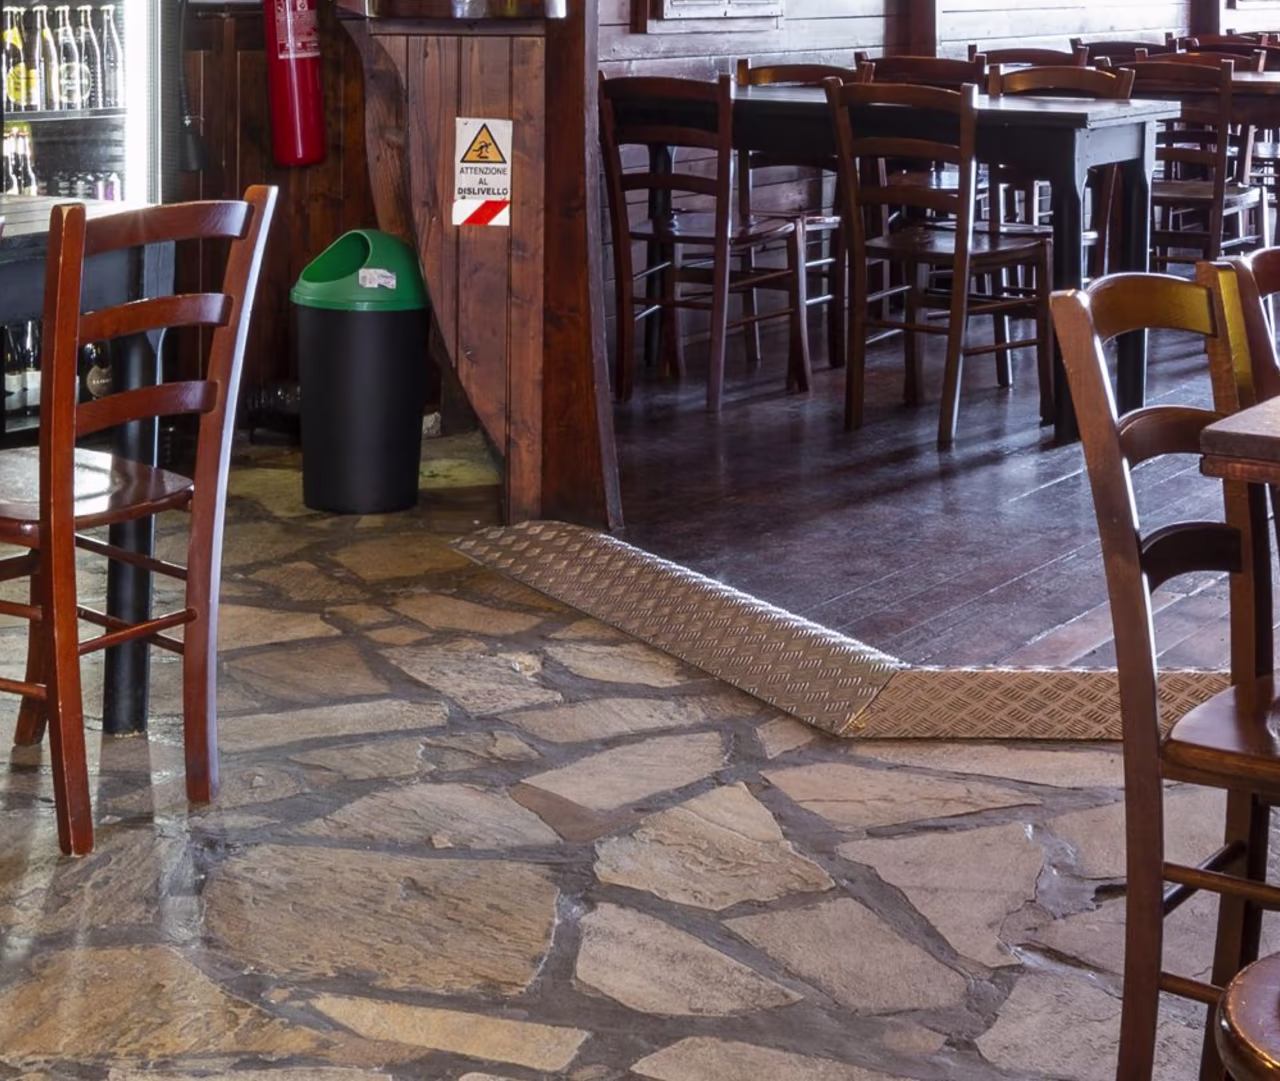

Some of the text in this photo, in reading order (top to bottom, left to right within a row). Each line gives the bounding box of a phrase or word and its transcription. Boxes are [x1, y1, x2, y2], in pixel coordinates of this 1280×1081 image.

[460, 166, 507, 175] ATTENZIONE
[478, 177, 488, 185] AL
[457, 187, 508, 196] DISLIVELLO
